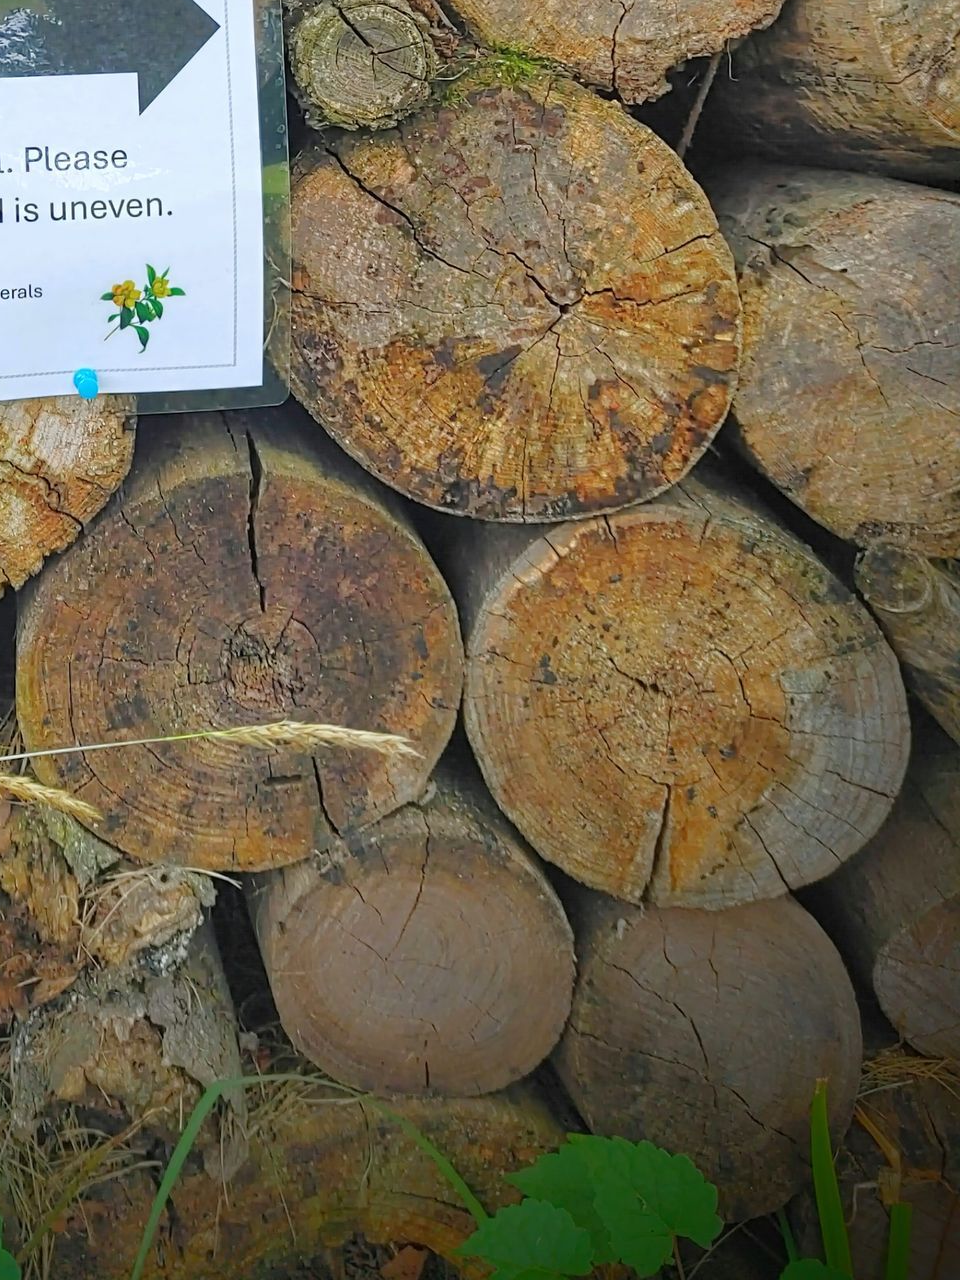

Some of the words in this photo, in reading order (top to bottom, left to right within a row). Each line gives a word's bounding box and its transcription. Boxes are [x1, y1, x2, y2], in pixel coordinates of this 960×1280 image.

[25, 146, 127, 172] Please
[15, 197, 39, 223] is
[50, 197, 172, 221] uneven.
